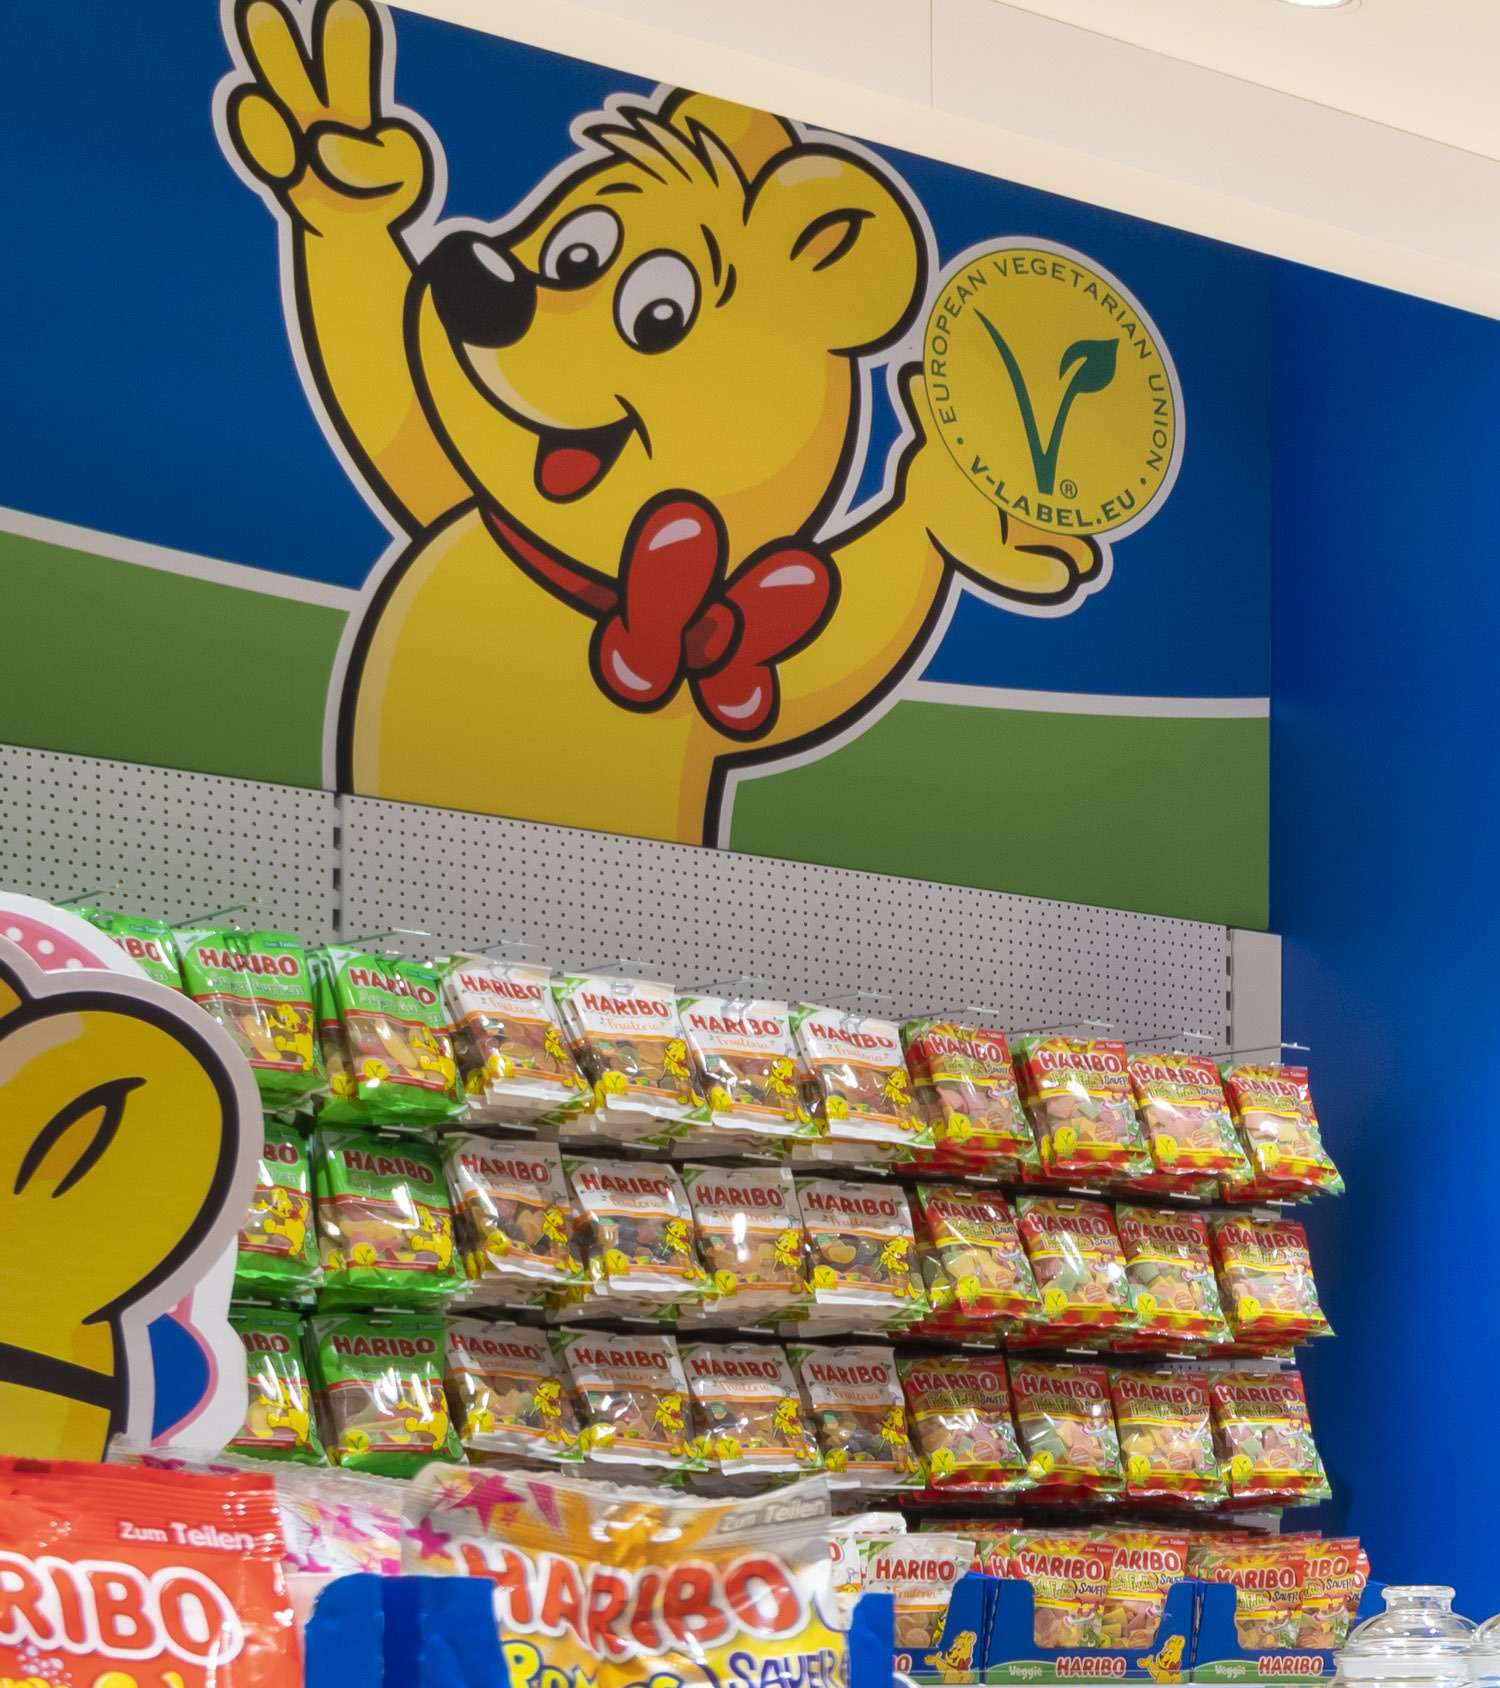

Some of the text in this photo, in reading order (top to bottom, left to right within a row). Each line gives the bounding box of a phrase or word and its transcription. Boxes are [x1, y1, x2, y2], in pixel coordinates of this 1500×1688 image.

[931, 257, 1169, 471] EUROPEAN VEGETARIAN UNION
[971, 455, 1136, 527] V-LABEL.EU
[582, 989, 670, 1018] HARIBO
[1038, 1049, 1120, 1075] HARIBO
[461, 1153, 549, 1183] HARIBO
[580, 1171, 670, 1199] HARIBO
[806, 1192, 895, 1219] HARIBO
[332, 1333, 436, 1358] HARIBO
[911, 1371, 1000, 1395] HARIBO
[1021, 1376, 1103, 1399] HARIBO
[120, 1521, 255, 1551] Zum Teilen
[875, 1558, 955, 1581] HARIBO
[1021, 1552, 1104, 1578] HARIBO
[1114, 1550, 1179, 1571] ARIBO
[1216, 1567, 1296, 1589] HARIBO
[0, 1553, 238, 1663] RIBO
[460, 1543, 800, 1658] HARIBO
[1057, 1656, 1125, 1677] HARIBO
[1258, 1656, 1322, 1677] HARIBO
